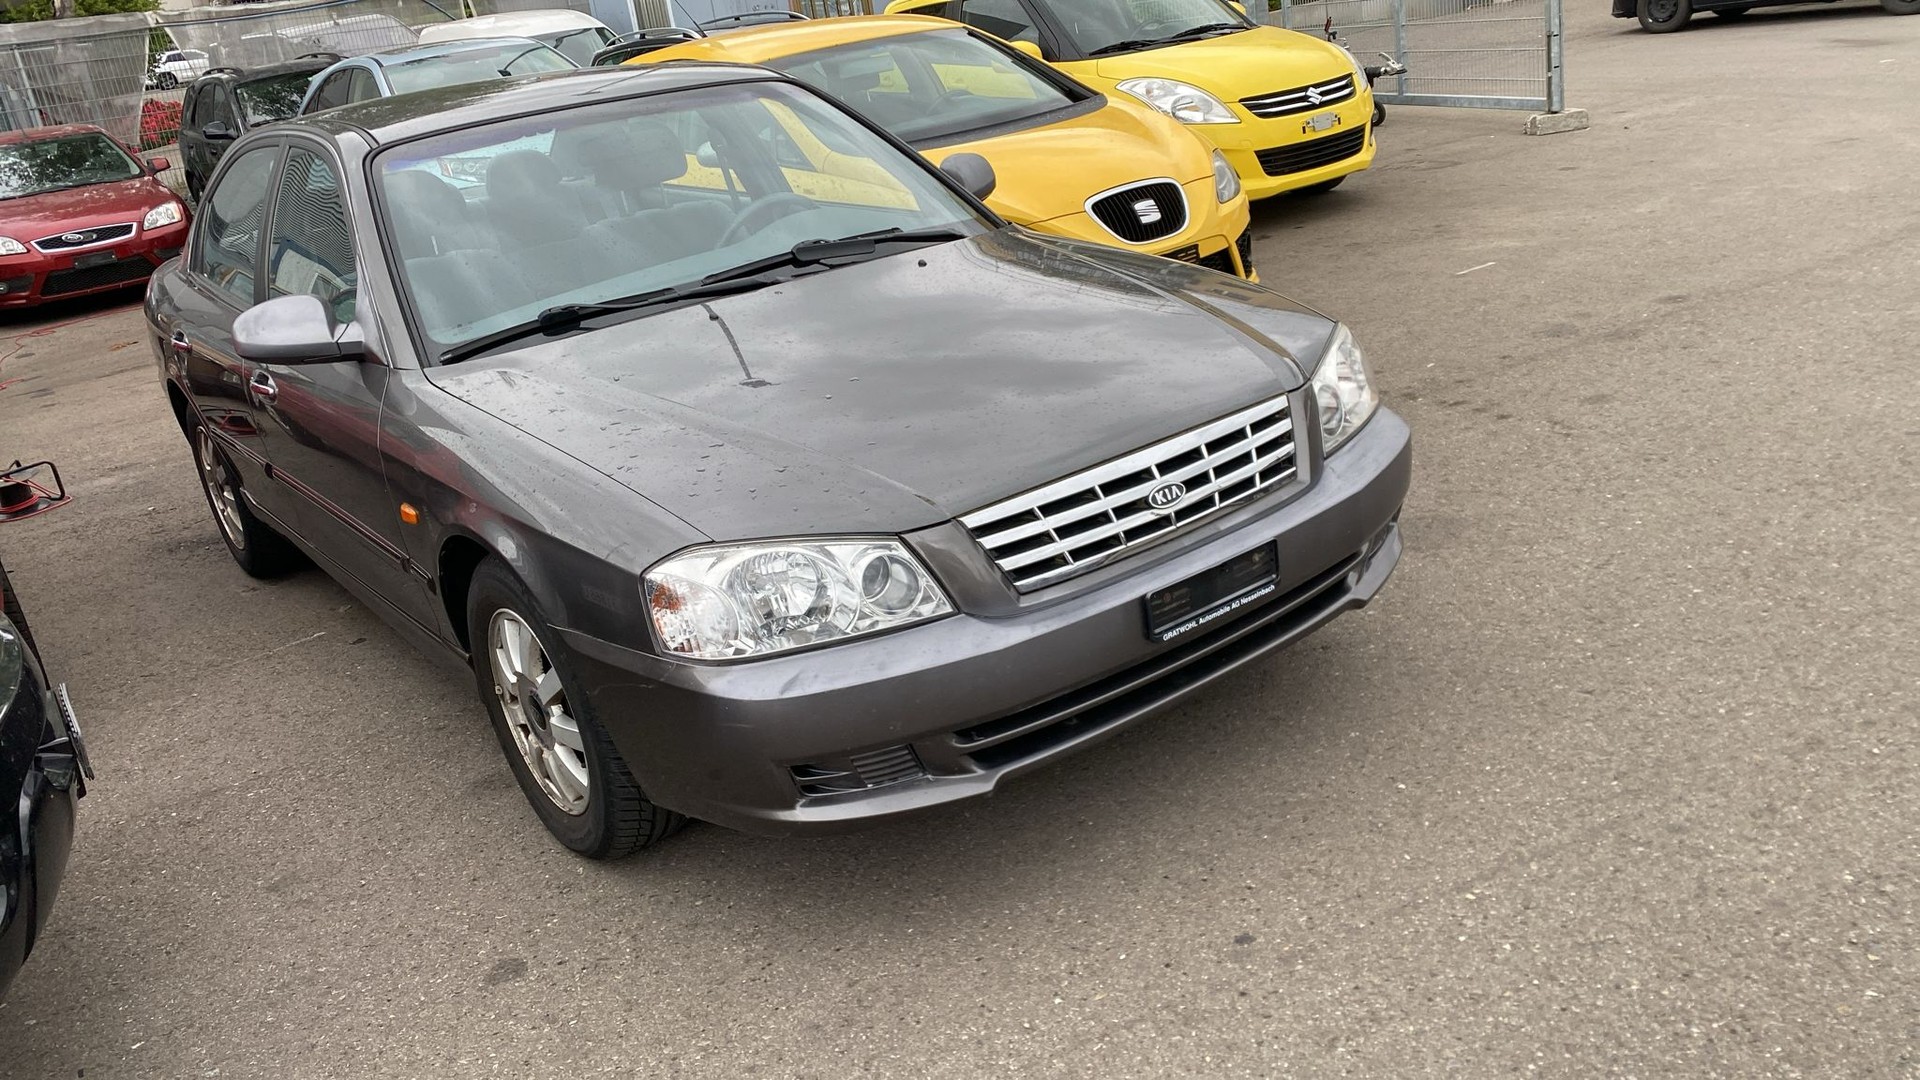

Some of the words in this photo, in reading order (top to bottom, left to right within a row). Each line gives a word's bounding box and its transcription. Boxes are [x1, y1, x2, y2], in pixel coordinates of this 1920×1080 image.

[1154, 485, 1181, 505] KIA
[1163, 621, 1198, 642] GRATWOHL
[1199, 606, 1231, 625] Automobile
[1231, 600, 1240, 610] AG
